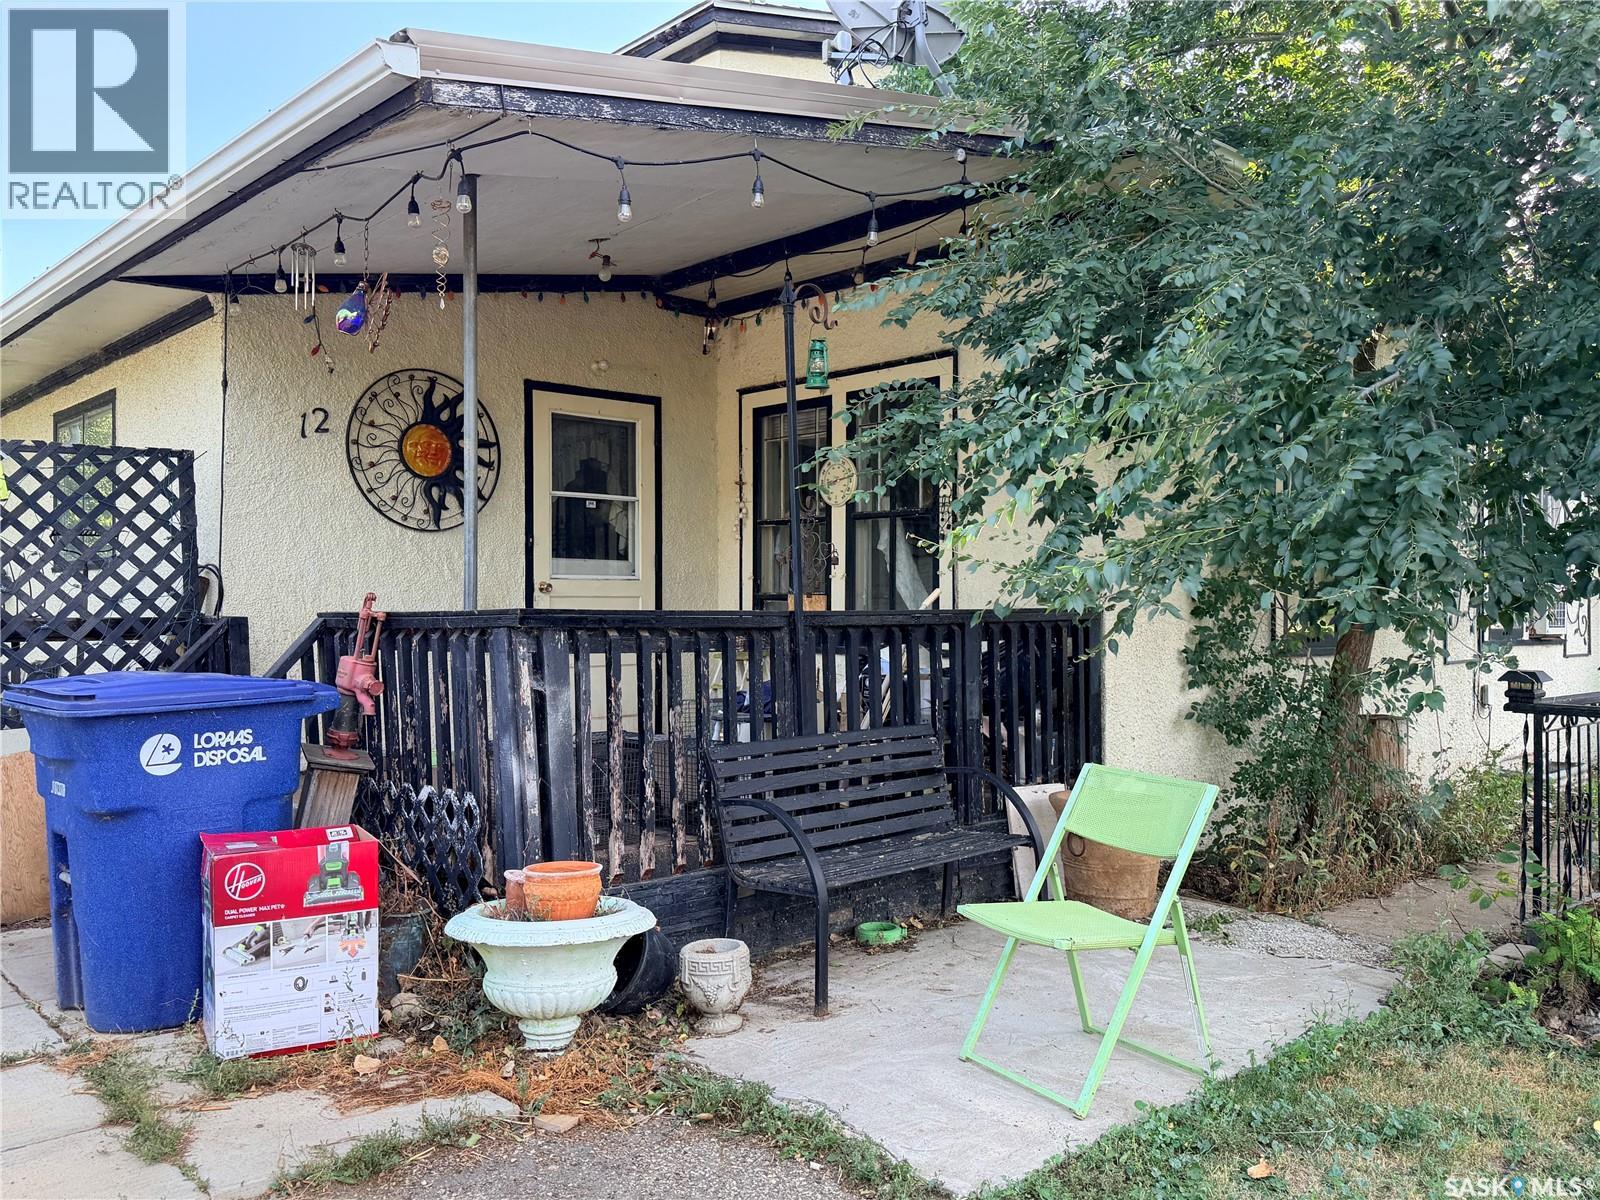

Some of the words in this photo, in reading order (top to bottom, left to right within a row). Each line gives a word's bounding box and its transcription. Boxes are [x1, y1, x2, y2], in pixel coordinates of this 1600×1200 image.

[300, 407, 330, 439] 12
[193, 728, 253, 749] LORAAS
[193, 745, 267, 767] DISPOSAL
[239, 906, 258, 914] POWER
